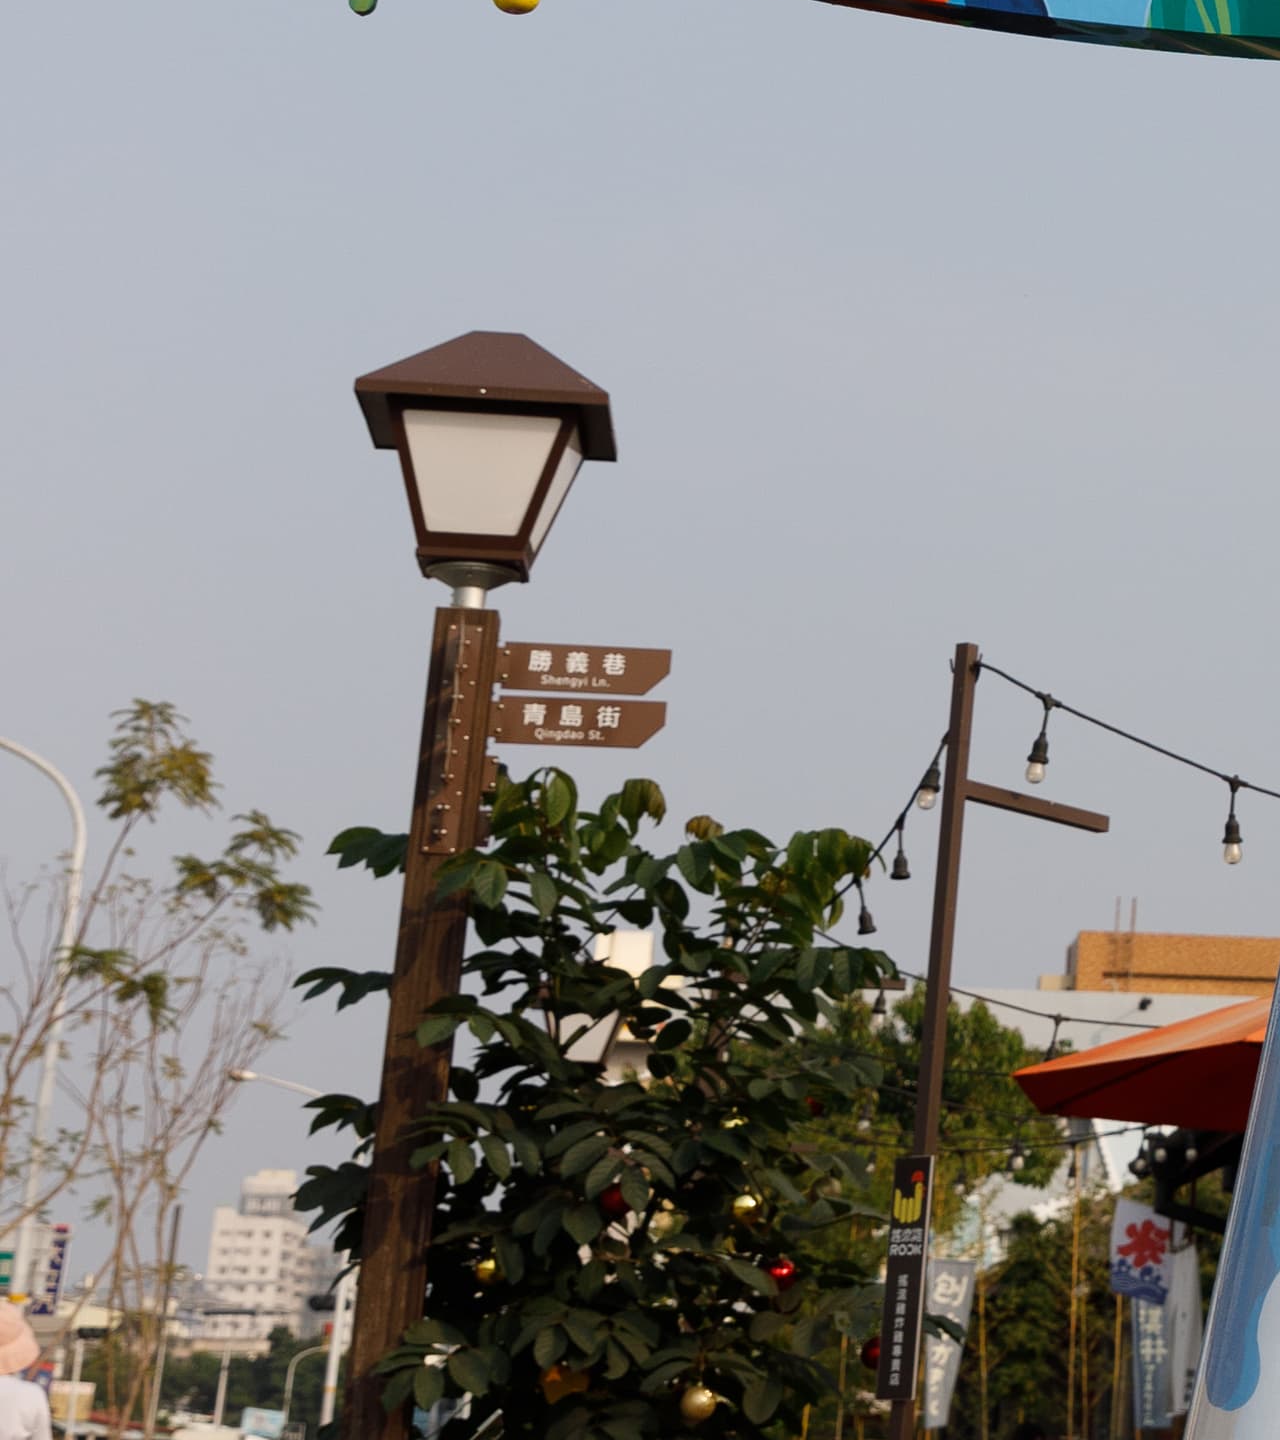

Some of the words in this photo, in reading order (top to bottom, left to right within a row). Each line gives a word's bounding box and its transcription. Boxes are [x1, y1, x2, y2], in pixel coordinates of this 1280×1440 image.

[528, 650, 627, 676] 勝義巷
[541, 674, 589, 689] Shengyi
[592, 677, 611, 688] Ln.
[523, 703, 621, 728] 青島街
[534, 727, 584, 741] Qingdao
[588, 730, 605, 740] St.
[889, 1243, 922, 1257] ROCK
